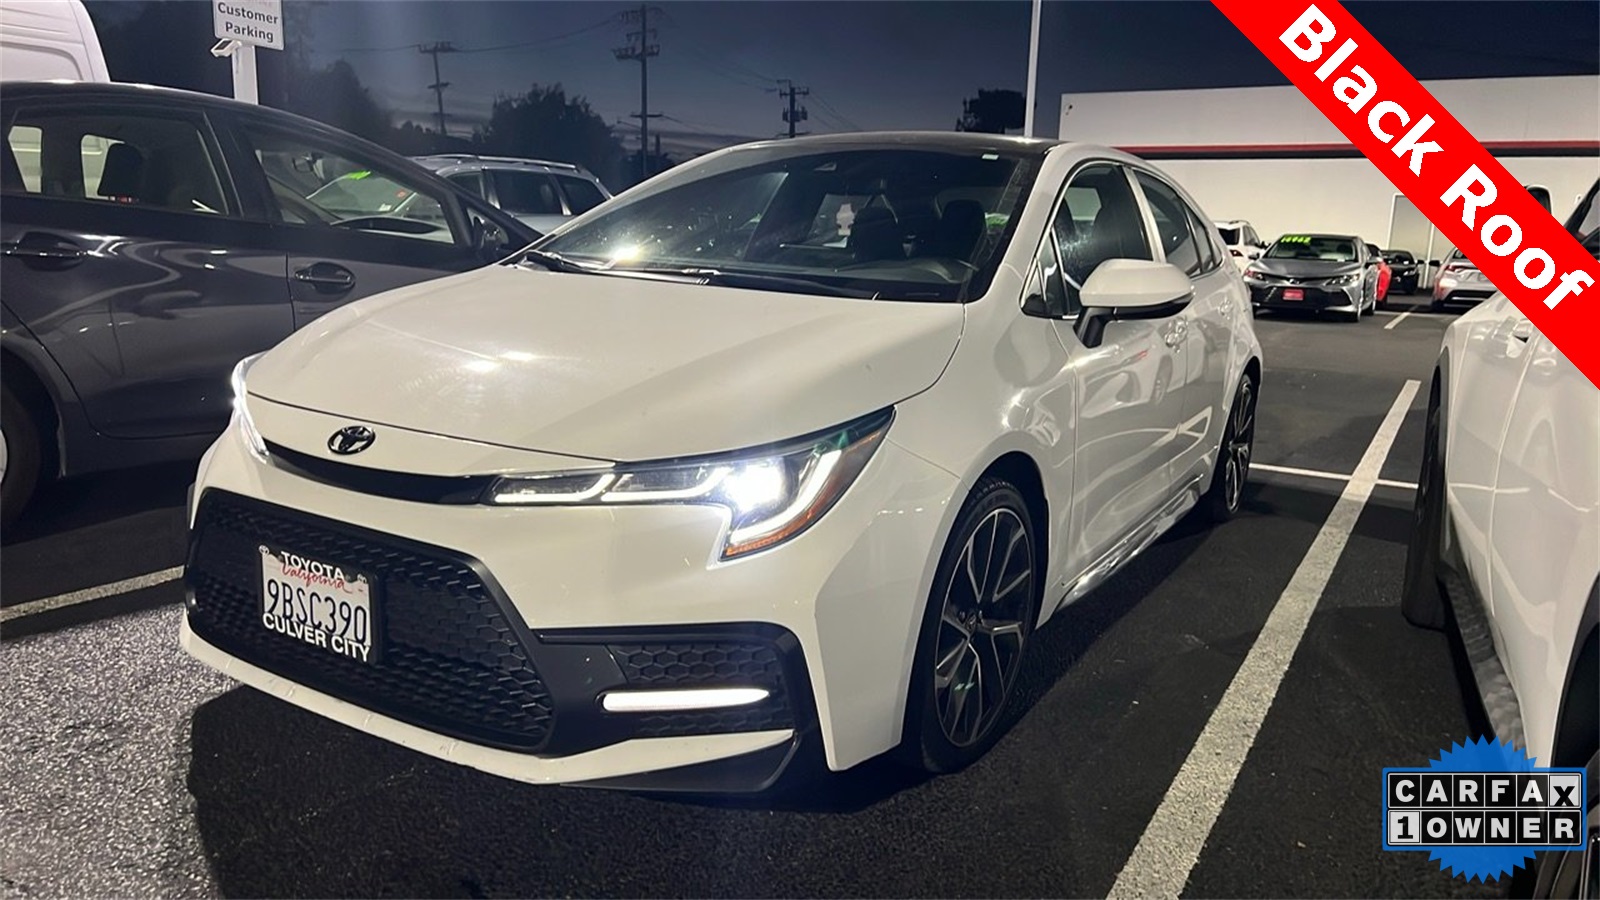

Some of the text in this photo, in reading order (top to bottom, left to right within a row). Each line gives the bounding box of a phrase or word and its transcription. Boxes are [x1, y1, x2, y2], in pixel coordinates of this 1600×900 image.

[217, 2, 279, 24] Customer
[225, 21, 274, 43] Parking
[280, 551, 345, 580] TOYOTA
[267, 579, 367, 644] 9BSC390
[263, 613, 370, 662] CULVER CITY
